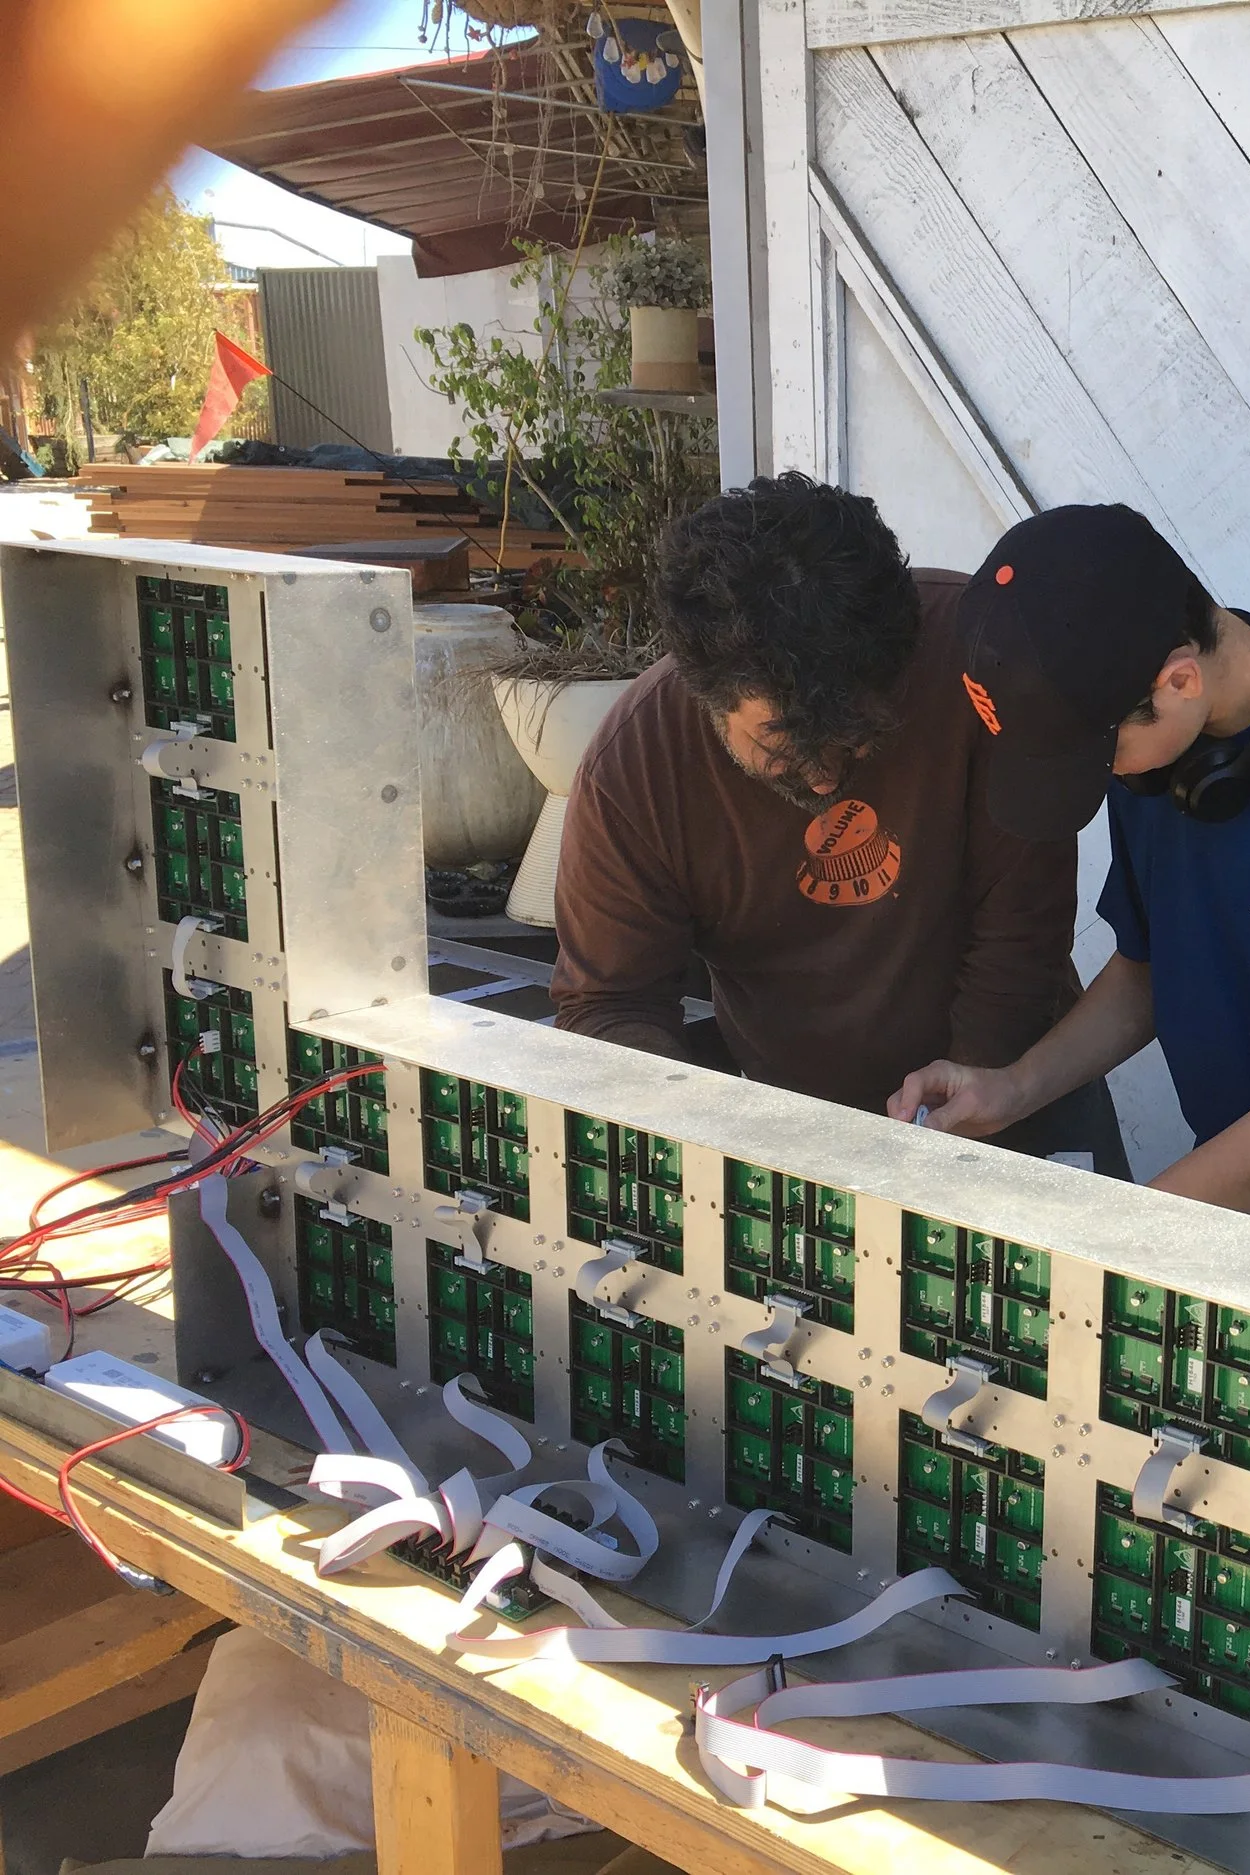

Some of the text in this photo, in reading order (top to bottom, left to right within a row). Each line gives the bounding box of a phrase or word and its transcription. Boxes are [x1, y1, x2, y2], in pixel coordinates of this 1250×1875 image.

[816, 801, 866, 855] VOLUME
[829, 883, 840, 900] 9
[853, 878, 870, 897] 10
[877, 868, 892, 887] 11
